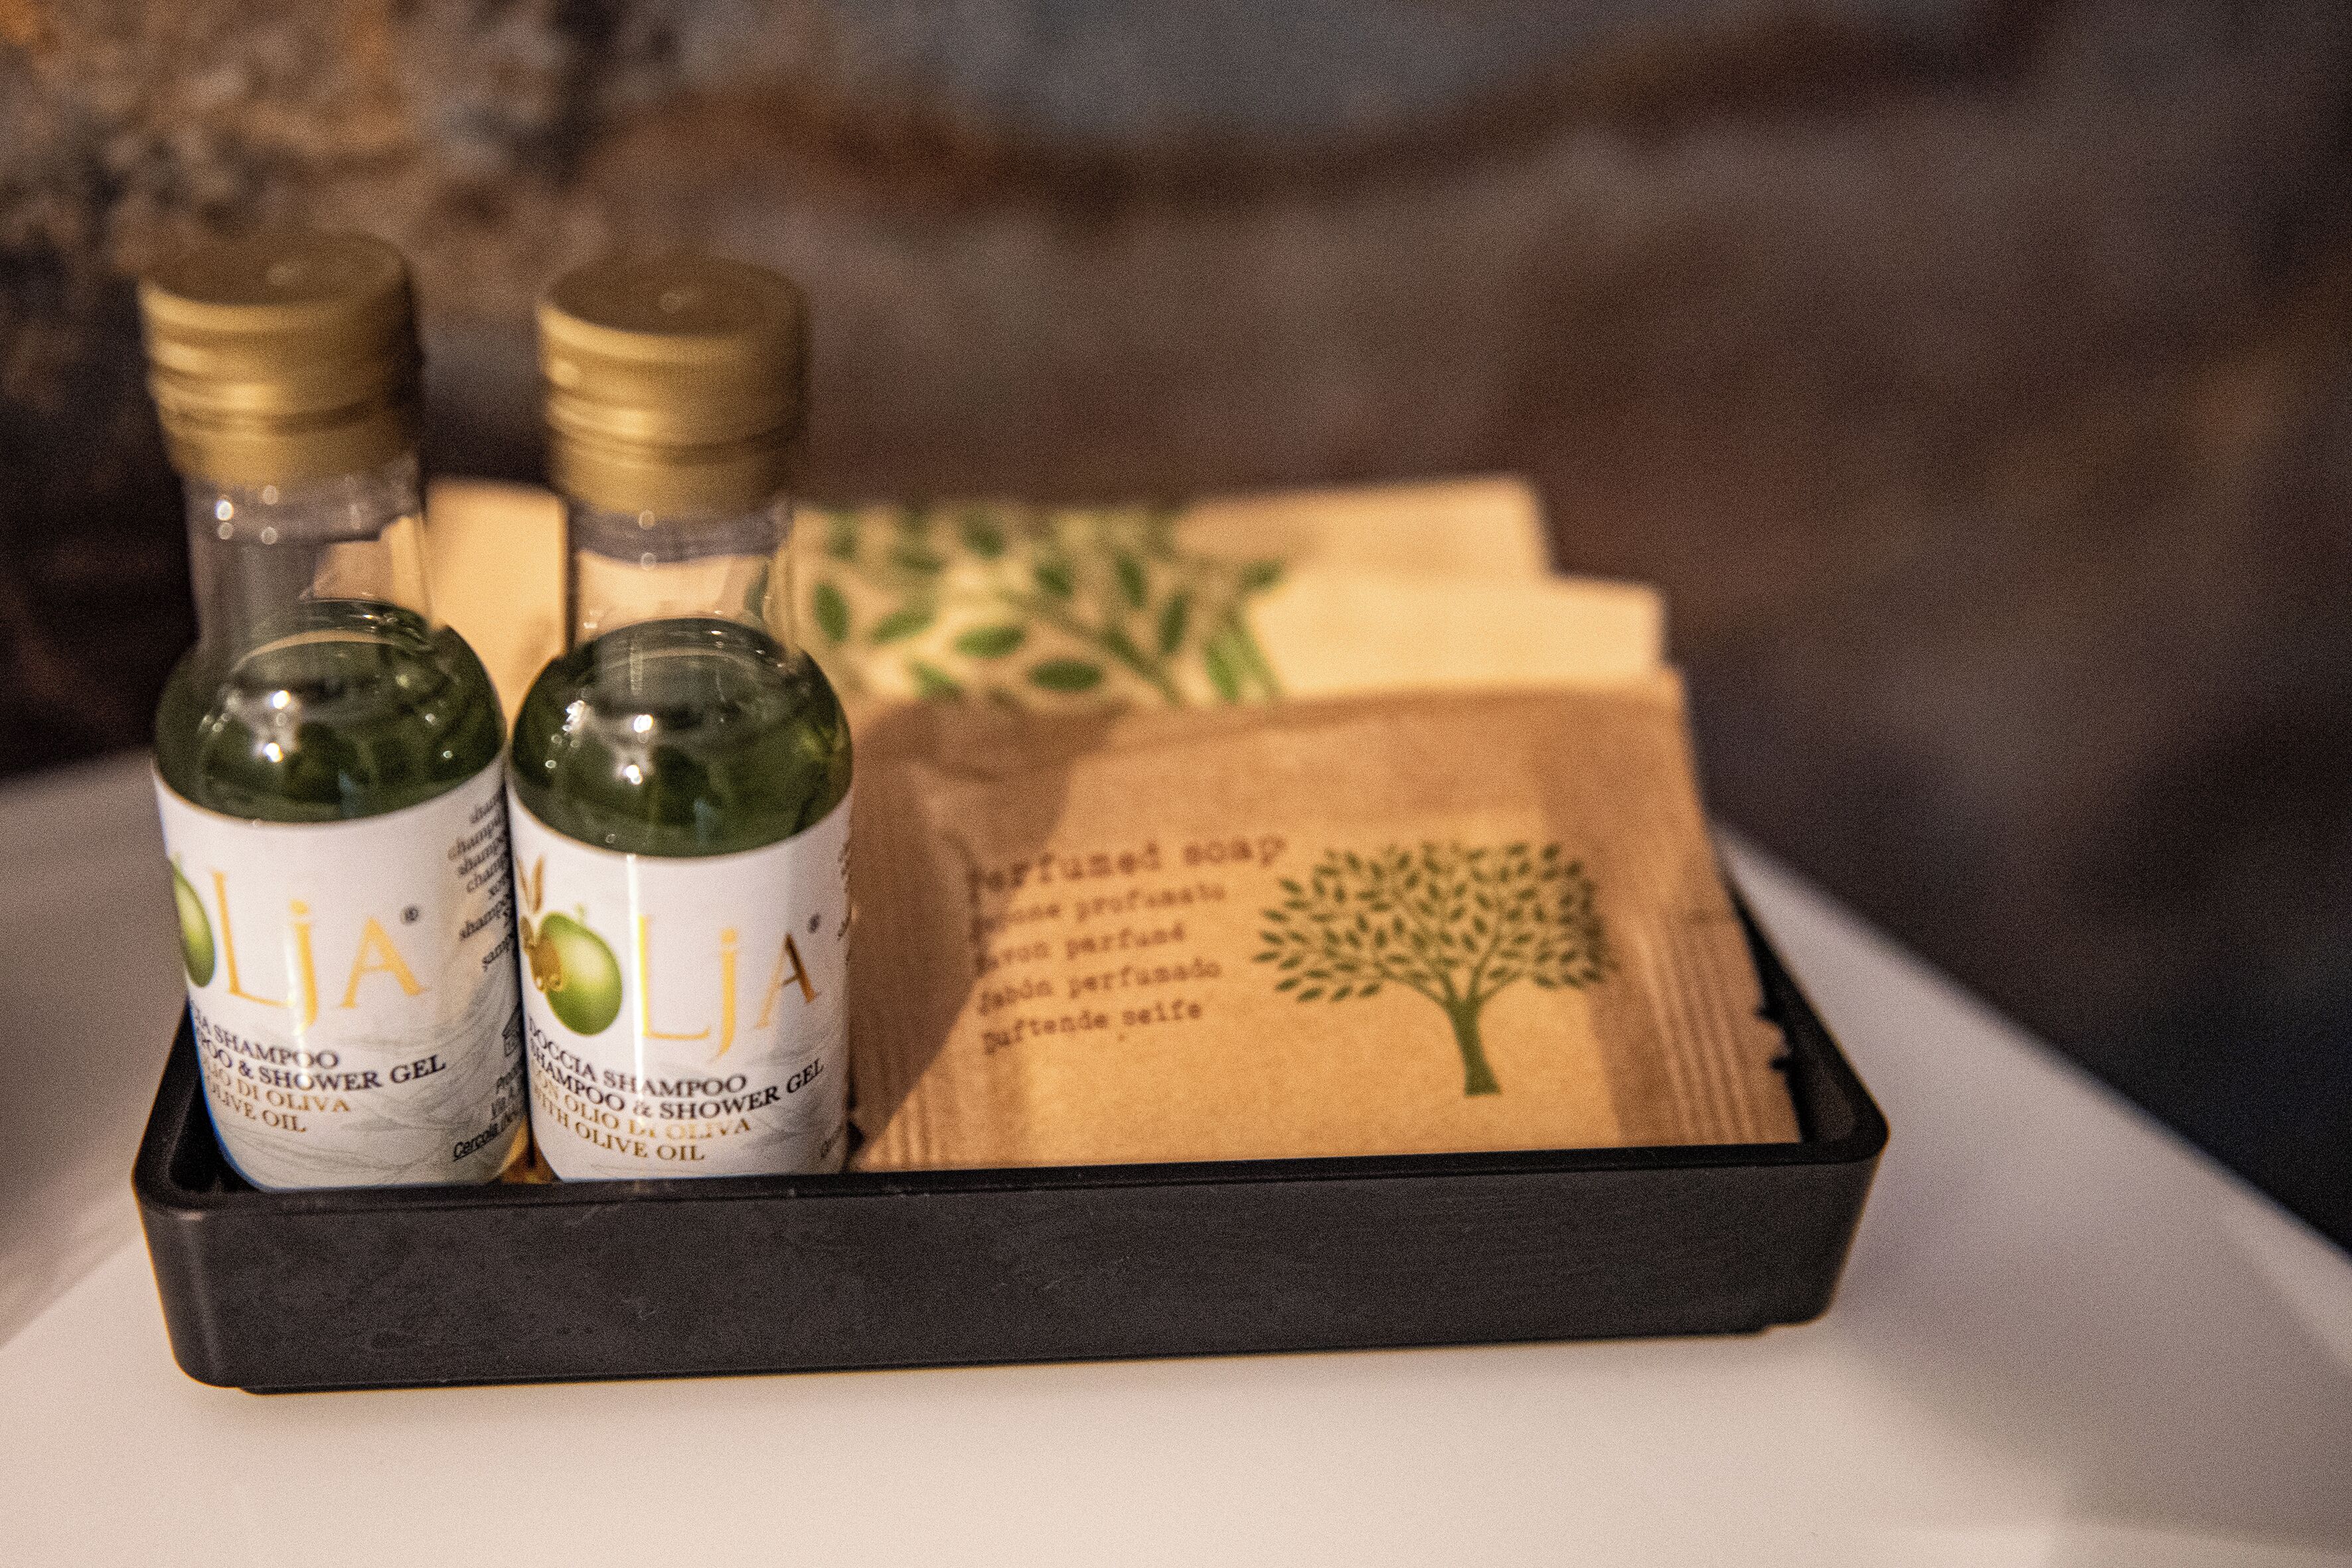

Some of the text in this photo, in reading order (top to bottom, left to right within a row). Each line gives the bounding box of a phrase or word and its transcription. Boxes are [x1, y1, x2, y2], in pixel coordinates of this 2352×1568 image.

[1182, 836, 1287, 867] soap
[1068, 956, 1222, 999] perfumado
[213, 1024, 341, 1069] SHAMPOO
[238, 1054, 447, 1092] & SHOWER GEL
[602, 1069, 747, 1098] SHAMPOO
[633, 1099, 653, 1117] &
[659, 1085, 781, 1120] SHOWER
[786, 1057, 824, 1095] GEL
[237, 1079, 259, 1101] DI
[266, 1089, 351, 1113] OLIVA
[262, 1109, 307, 1133] OIL
[564, 1093, 619, 1129] OLIO
[666, 1118, 751, 1140] OLIVA
[574, 1119, 648, 1158] OLIVE
[655, 1144, 705, 1162] OIL
